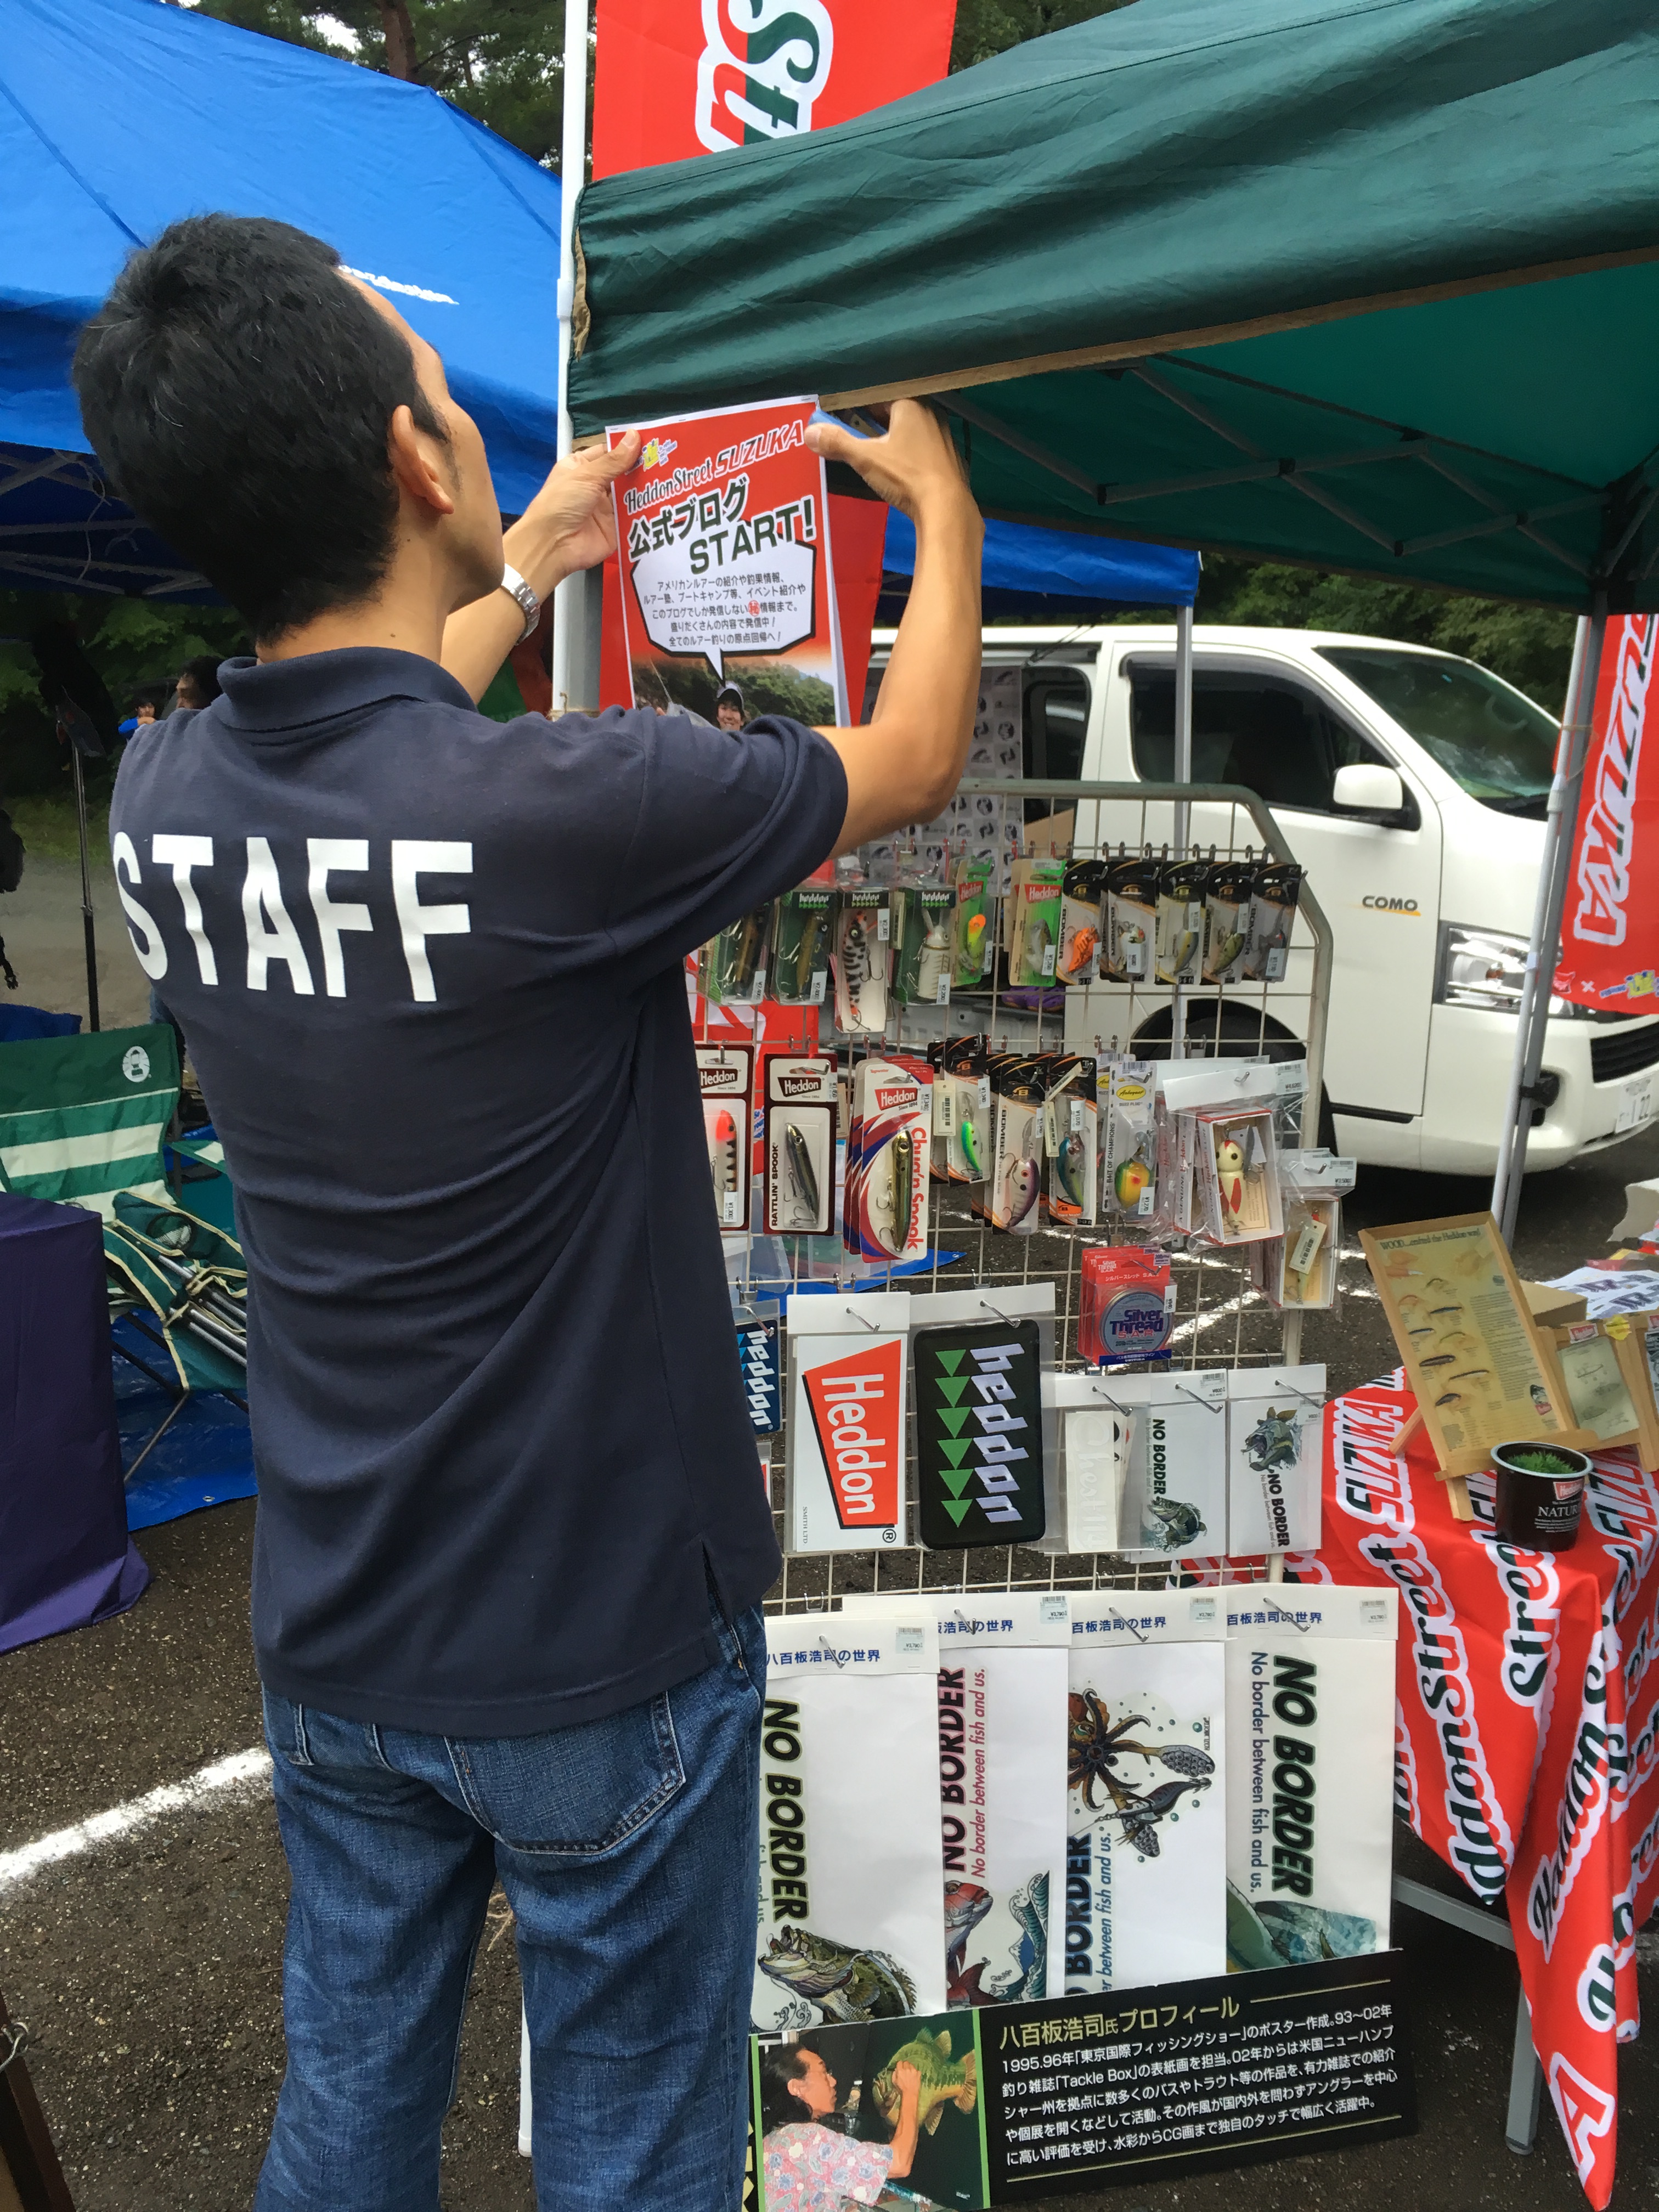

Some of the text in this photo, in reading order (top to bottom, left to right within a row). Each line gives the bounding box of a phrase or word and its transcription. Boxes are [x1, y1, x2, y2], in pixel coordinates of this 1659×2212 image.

[714, 420, 804, 477] SUZUKA
[629, 474, 748, 558] 公式ブログ
[690, 498, 815, 574] START!
[113, 832, 473, 1002] STAFF
[1029, 887, 1059, 900] Heddon
[1362, 896, 1418, 912] COMO
[701, 1070, 735, 1086] Heddon
[785, 1079, 819, 1094] Heddon
[881, 1090, 915, 1107] Heddon
[1109, 1317, 1164, 1335] Thread
[1124, 1309, 1163, 1322] Silver
[747, 1330, 775, 1426] heddon
[821, 1374, 887, 1514] Heddon
[969, 1343, 1029, 1523] heddon
[1153, 1419, 1166, 1495] NO BORDER
[1267, 1474, 1290, 1547] NO BORDER
[1537, 1504, 1579, 1517] NATUR
[768, 1649, 881, 1666] 八百板浩司の世界
[939, 1667, 966, 1872] NO BORDER
[968, 1668, 986, 1878] No border between fish and us.
[1250, 1652, 1269, 1893] No border between fish and us.
[1271, 1654, 1318, 1898] NO BORDER
[764, 1700, 809, 1922] NO BORDER
[1094, 1855, 1111, 1885] and
[1100, 1832, 1111, 1853] us.
[1066, 1833, 1093, 1976] BORDER
[1094, 1889, 1111, 1914] fish
[1096, 1918, 1112, 1977] between
[999, 1996, 1240, 2050] 八百板浩司氏プロフィール
